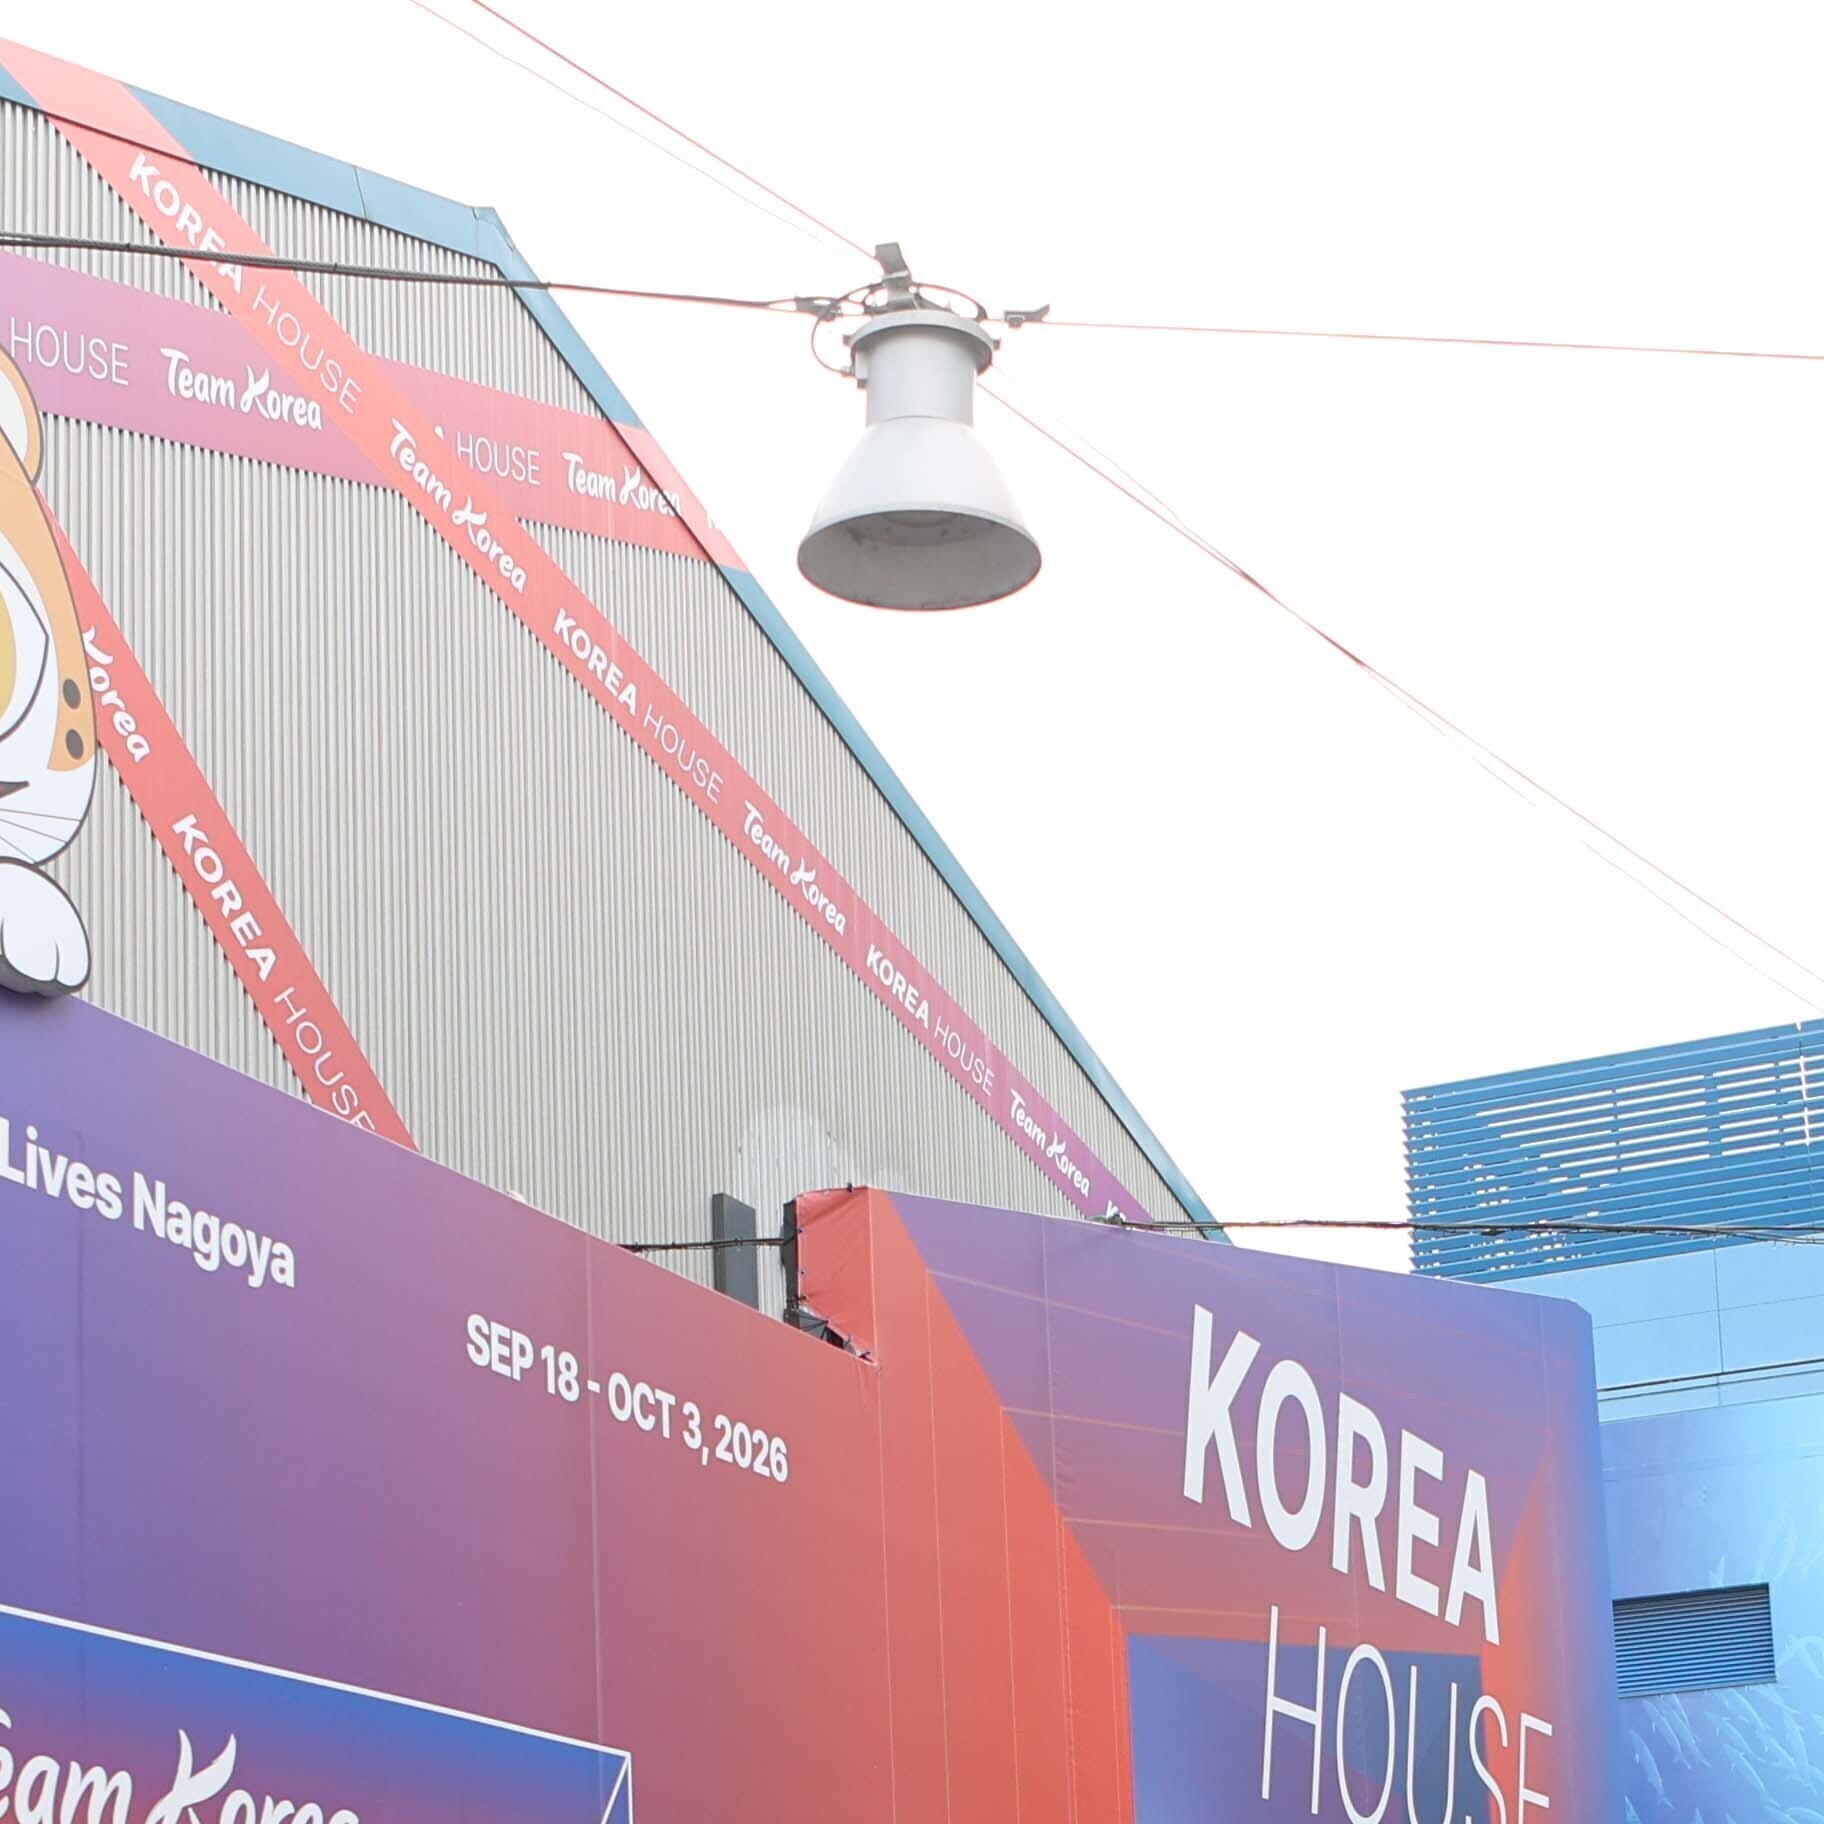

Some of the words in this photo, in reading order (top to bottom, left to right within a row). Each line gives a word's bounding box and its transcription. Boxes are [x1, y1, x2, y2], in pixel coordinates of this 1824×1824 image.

[9, 320, 131, 387] HOUSE
[160, 347, 237, 412] Team
[240, 365, 323, 431] Korea
[128, 152, 245, 294] KOREA
[251, 283, 363, 414] HOUSE
[455, 429, 542, 486] HOUSE
[562, 451, 618, 505] Team
[619, 463, 682, 518] Korea
[83, 626, 151, 764] Korea
[172, 813, 277, 982] KOREA
[274, 986, 376, 1133] HOUSE
[389, 417, 452, 511] Team
[452, 495, 527, 593] Korea
[552, 607, 640, 716] KOREA
[642, 704, 725, 805] HOUSE
[744, 800, 791, 875] Team
[790, 857, 846, 935] Korea
[865, 943, 932, 1029] KOREA
[933, 1013, 996, 1097] HOUSE
[1008, 1088, 1048, 1149] Team
[1046, 1131, 1090, 1198] Korea
[131, 1170, 298, 1290] Nagoya
[465, 1313, 535, 1382] SEP
[540, 1343, 580, 1404] 18
[586, 1381, 601, 1392] -
[606, 1371, 677, 1440] OCT
[681, 1401, 710, 1466] 3,
[713, 1411, 790, 1483] 2026
[1182, 1303, 1502, 1647] KOREA
